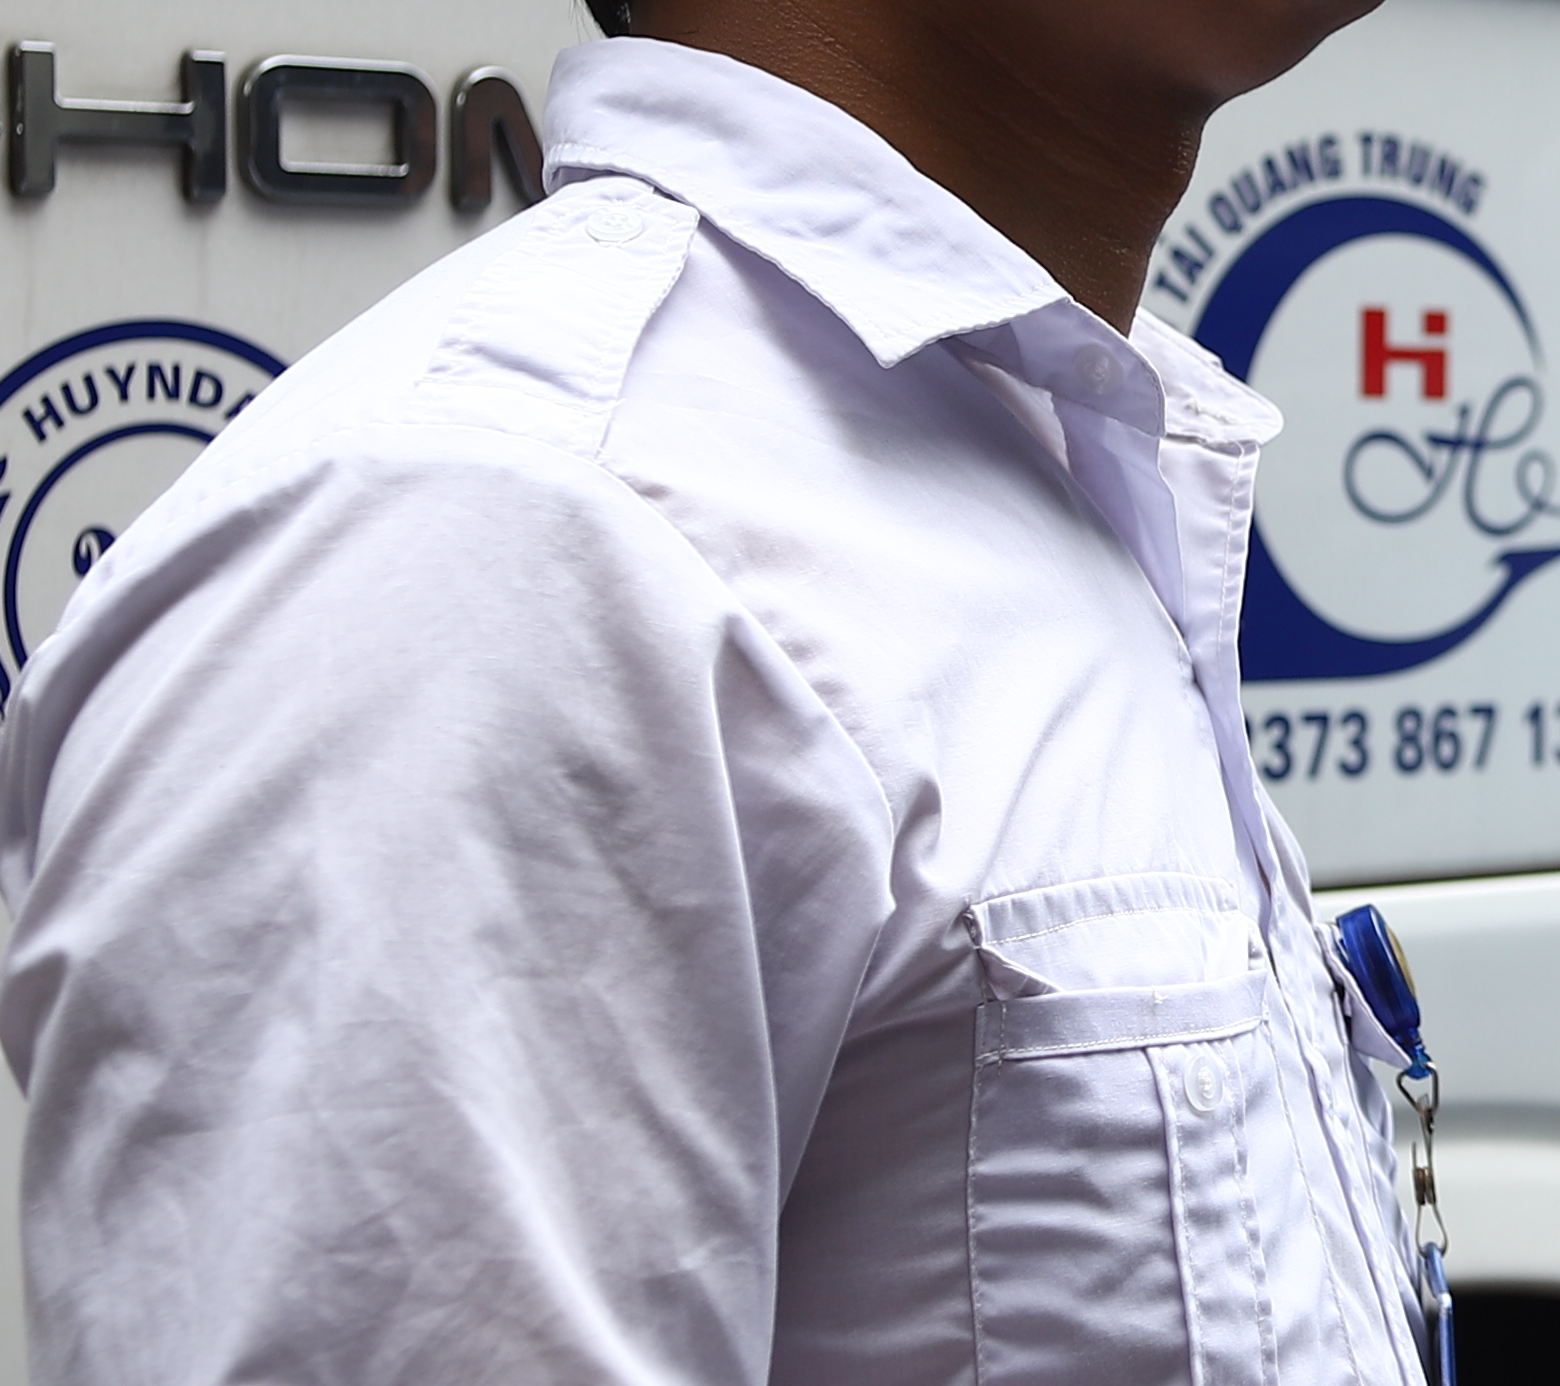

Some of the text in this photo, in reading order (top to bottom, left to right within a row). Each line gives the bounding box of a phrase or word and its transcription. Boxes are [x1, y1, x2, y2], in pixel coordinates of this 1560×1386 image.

[1208, 134, 1342, 235] QUANG
[1357, 131, 1487, 215] TRUNG
[1243, 709, 1370, 782] 373
[1393, 704, 1497, 775] 867
